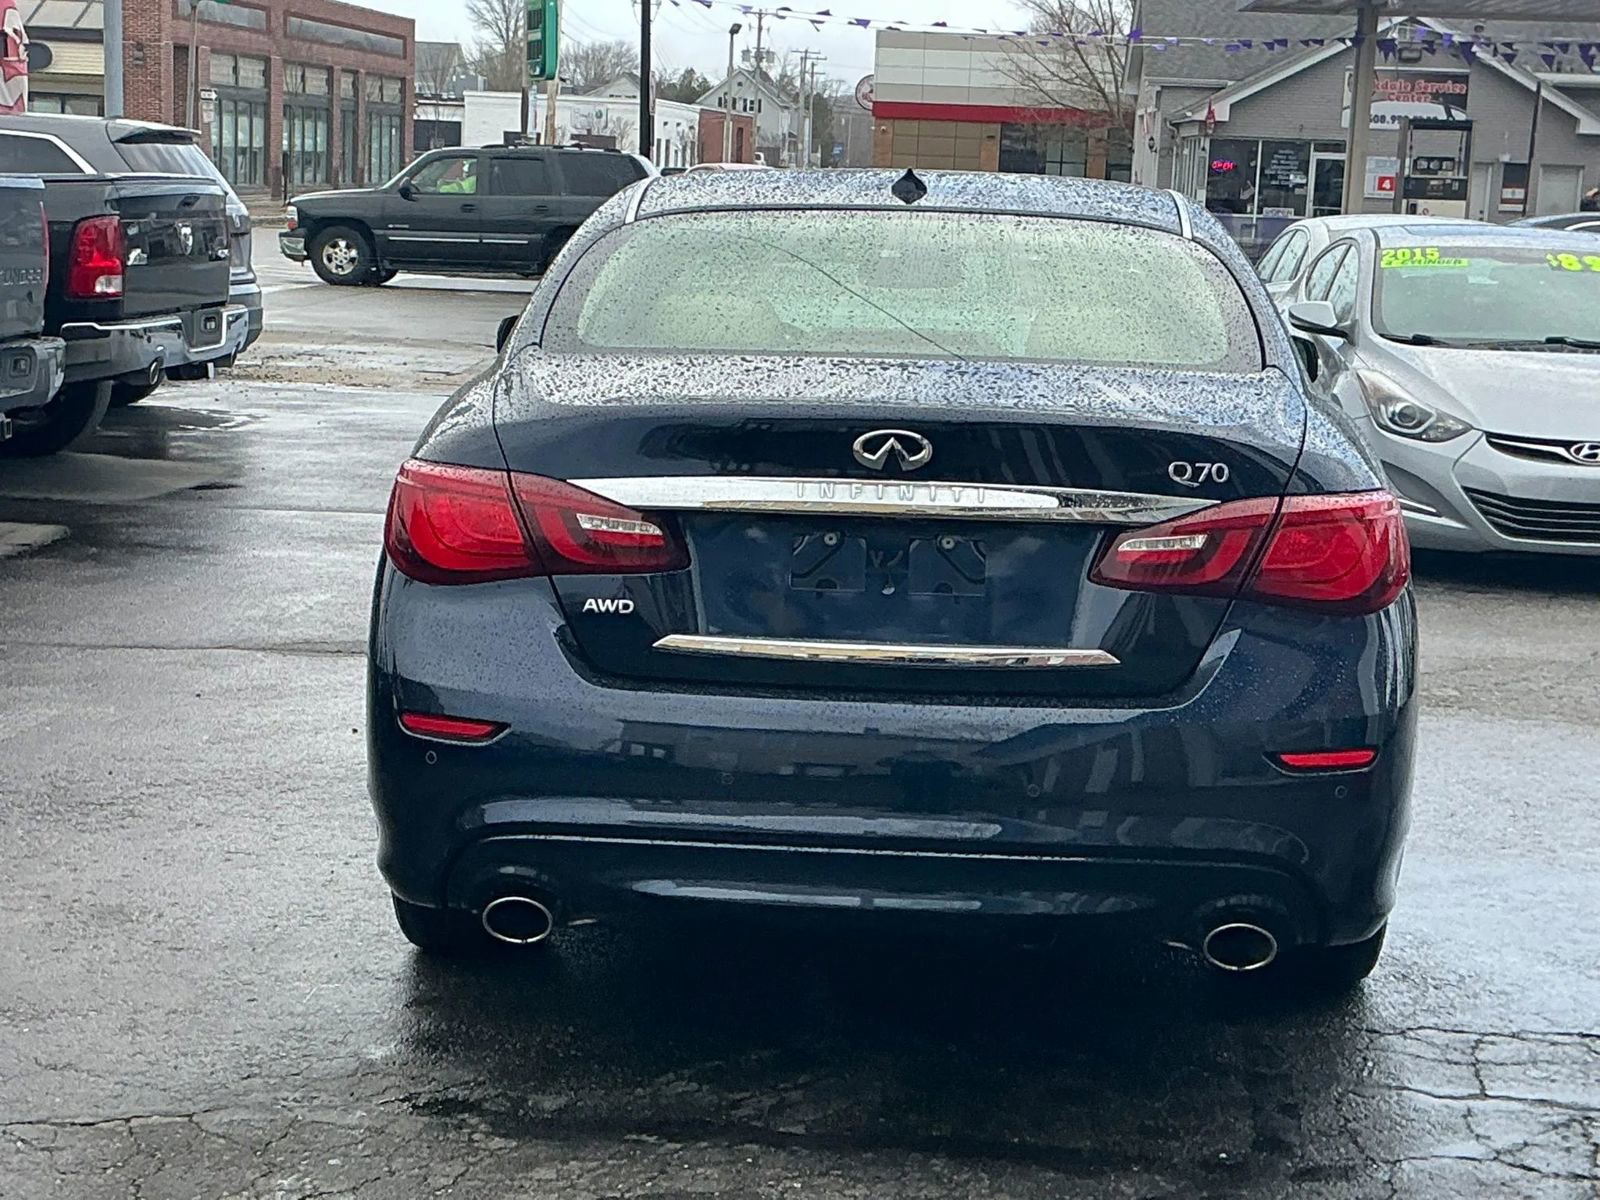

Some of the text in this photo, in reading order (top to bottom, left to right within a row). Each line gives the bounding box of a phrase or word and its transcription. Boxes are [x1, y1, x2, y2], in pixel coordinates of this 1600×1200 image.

[1415, 80, 1467, 94] Service
[1387, 93, 1431, 103] Center
[1211, 160, 1233, 170] OPEN
[1382, 247, 1440, 260] 2015
[1168, 461, 1229, 488] Q70
[797, 481, 985, 504] INFINITI
[582, 598, 635, 614] AWD
